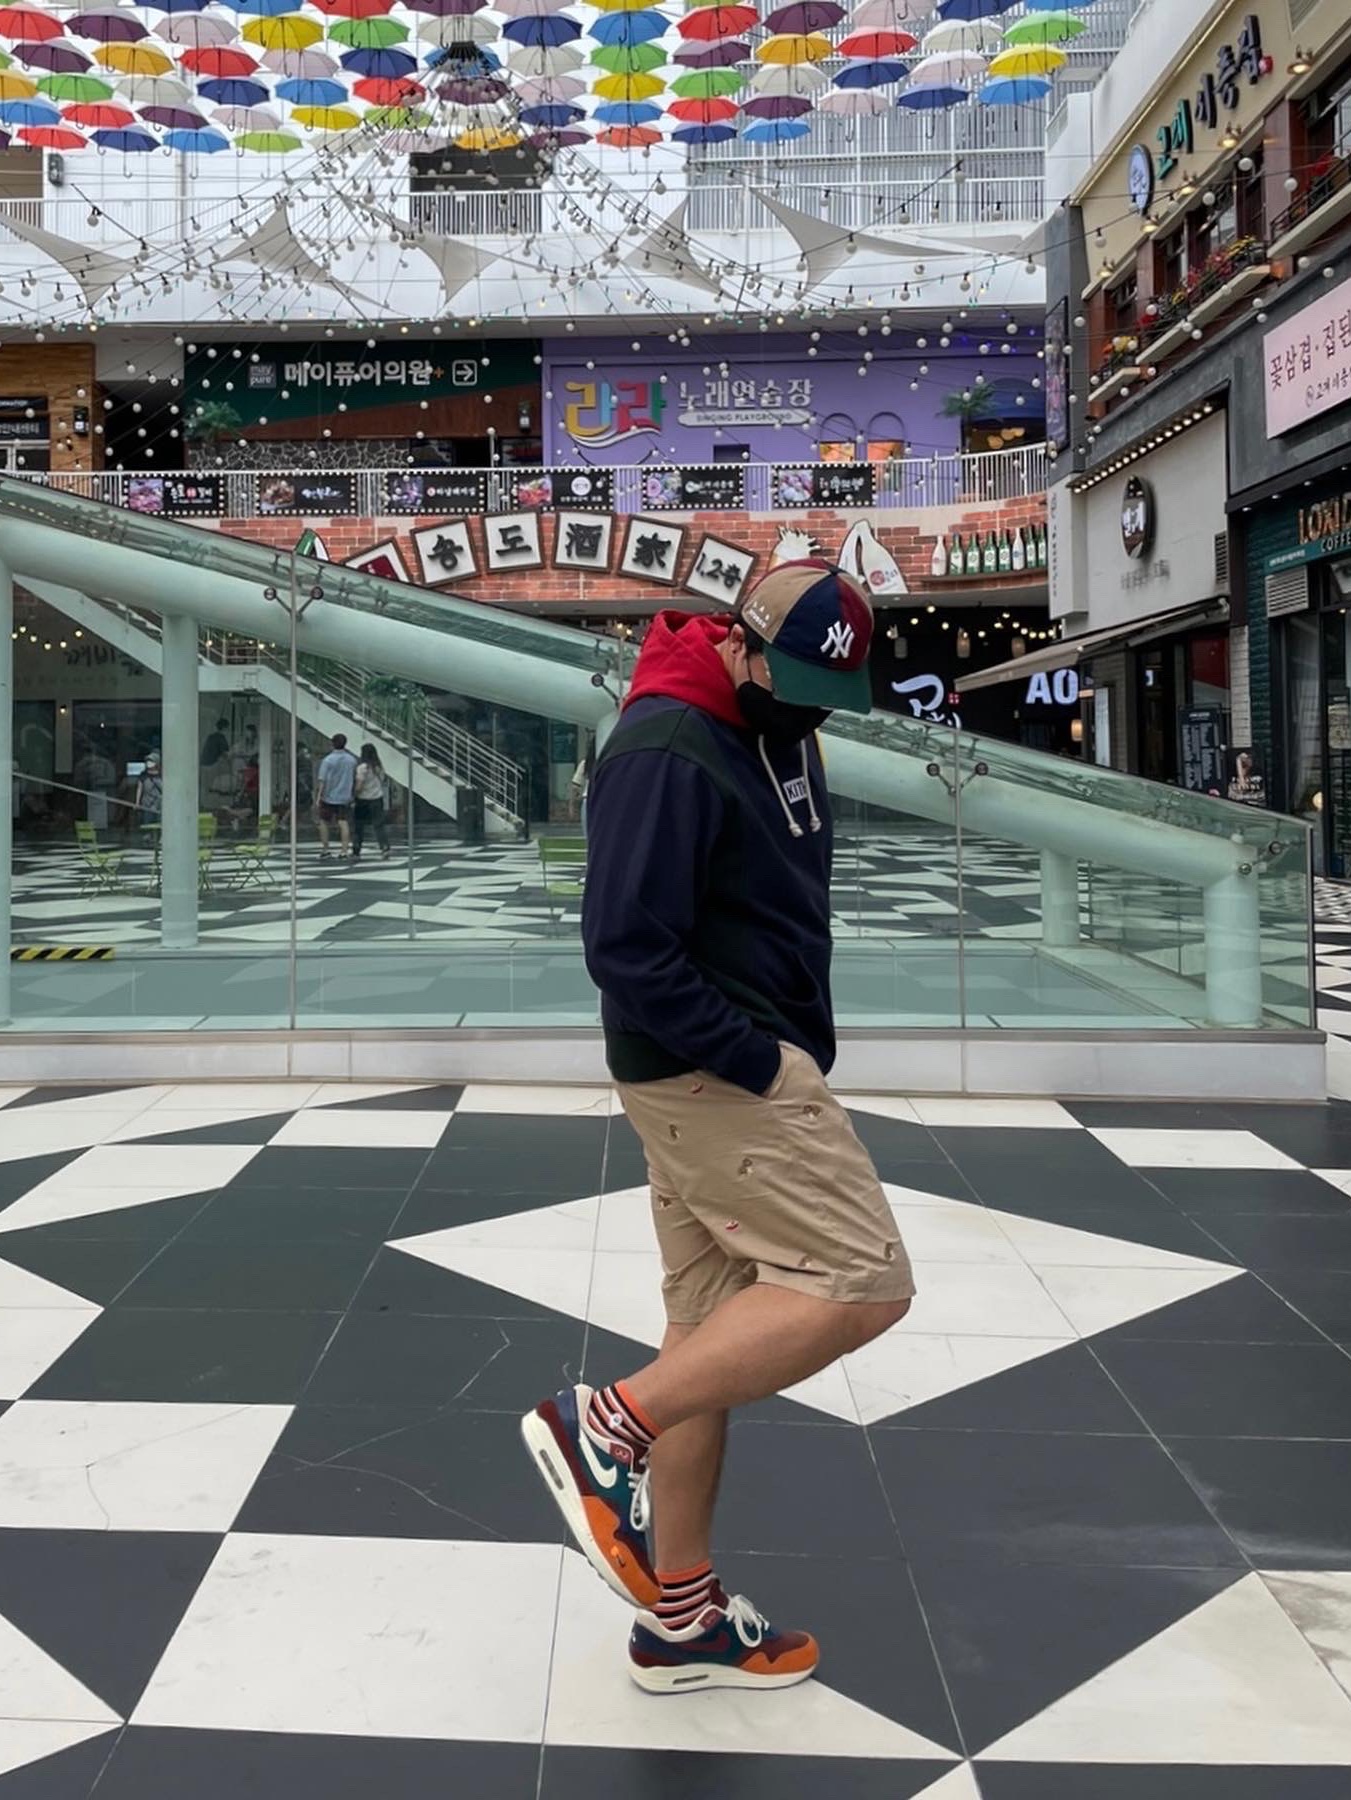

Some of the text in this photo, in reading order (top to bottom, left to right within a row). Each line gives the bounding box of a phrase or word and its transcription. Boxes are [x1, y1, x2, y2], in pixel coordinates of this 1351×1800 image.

[565, 380, 667, 436] 라라
[678, 379, 814, 409] 노래연습장
[820, 620, 855, 659] NY
